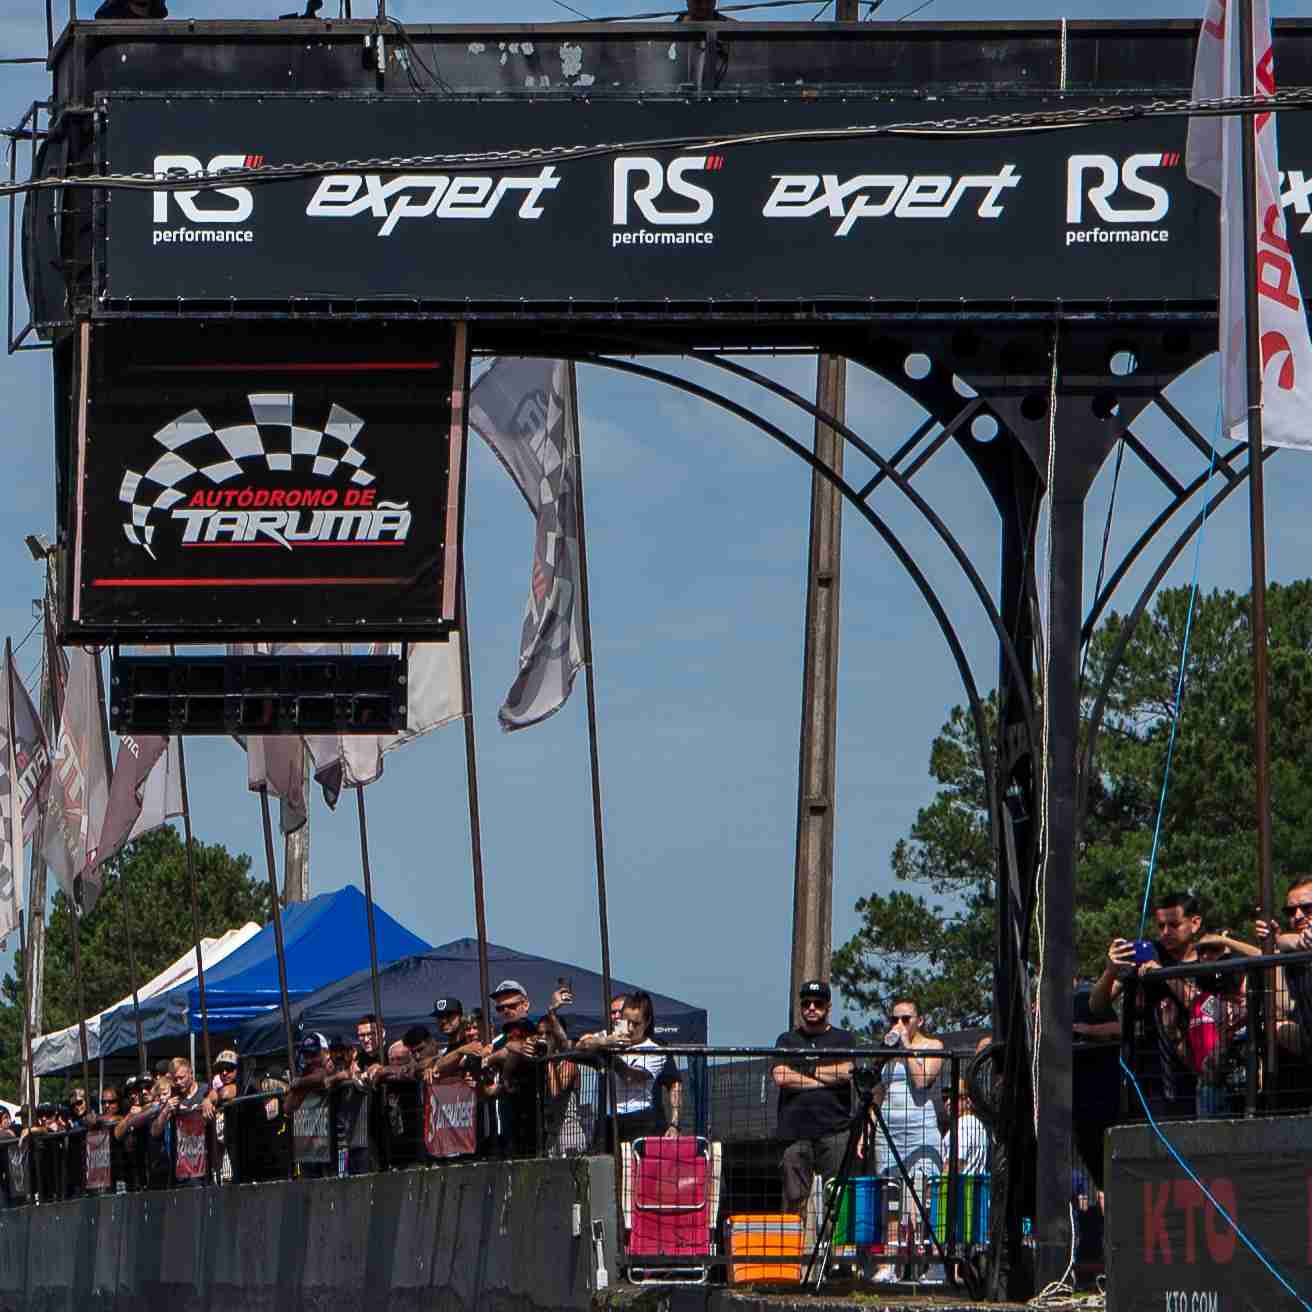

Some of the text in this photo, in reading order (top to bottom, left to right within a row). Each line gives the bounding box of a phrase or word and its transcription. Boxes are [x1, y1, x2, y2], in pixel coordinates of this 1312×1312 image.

[153, 154, 254, 222] RS
[305, 166, 562, 236] expert
[612, 156, 714, 225] RS
[762, 164, 1022, 236] expert
[1066, 153, 1169, 224] RS
[152, 227, 254, 245] performance
[612, 229, 714, 247] performance
[1066, 228, 1169, 246] performance
[171, 500, 412, 551] TARUMÃ
[188, 486, 376, 507] AUTÓDROMO DE
[1143, 1178, 1238, 1265] KTO
